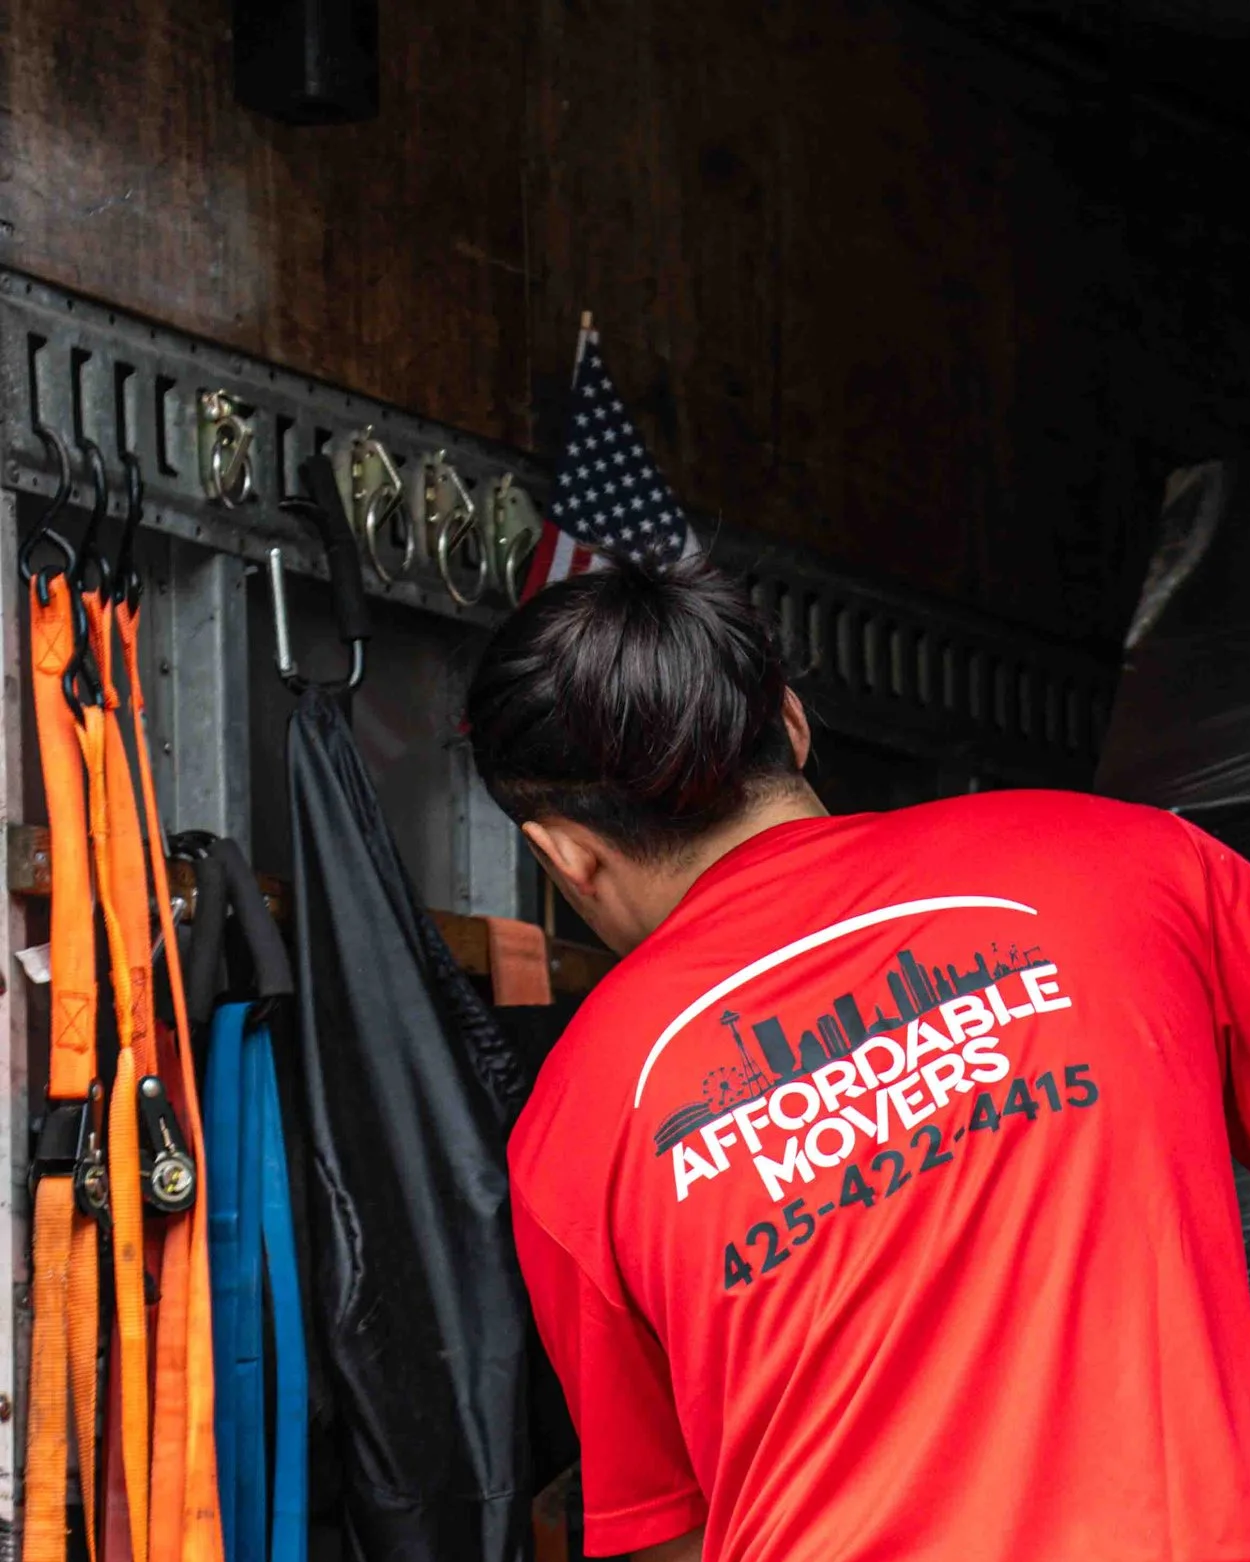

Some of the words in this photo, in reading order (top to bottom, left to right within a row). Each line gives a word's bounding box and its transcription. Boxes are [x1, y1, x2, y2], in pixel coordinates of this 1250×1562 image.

[672, 963, 1073, 1203] AFFORDABLE
[722, 1063, 1099, 1291] 425-422-4415
[752, 1036, 1010, 1203] MOVERS
